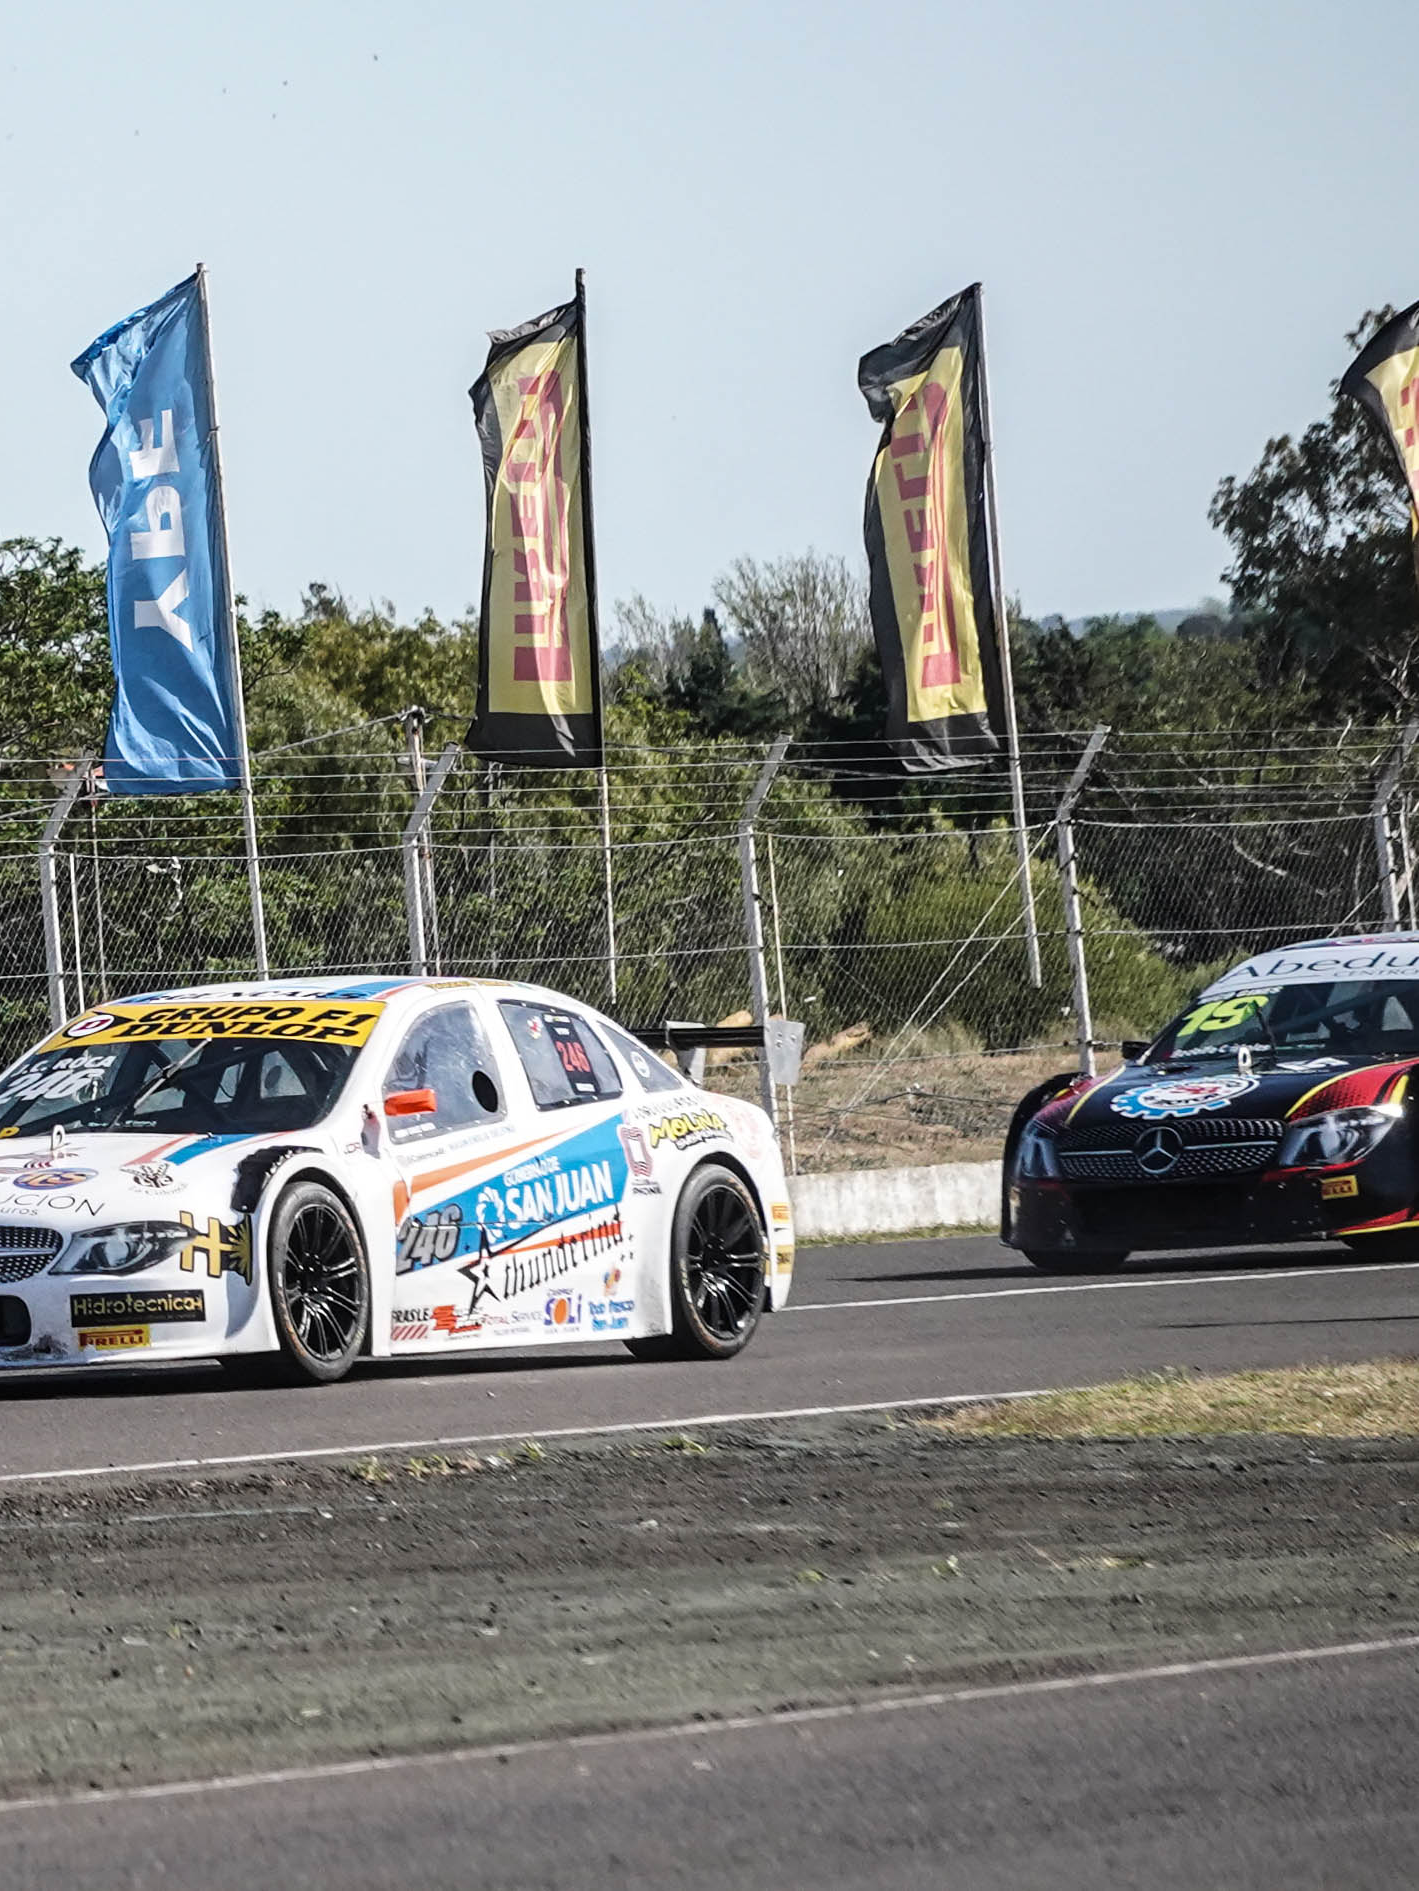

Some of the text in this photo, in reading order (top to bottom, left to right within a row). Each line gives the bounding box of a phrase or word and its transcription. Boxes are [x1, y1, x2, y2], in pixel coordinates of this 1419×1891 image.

[138, 1006, 378, 1027] GRUPO F1
[1176, 995, 1270, 1038] 19
[111, 1020, 359, 1041] DUNLOP
[52, 1055, 118, 1071] ROCA
[555, 1041, 590, 1073] 246
[505, 1160, 615, 1230] SAN JUAN
[396, 1203, 463, 1276] 246
[73, 1293, 203, 1316] Hidrotecnica
